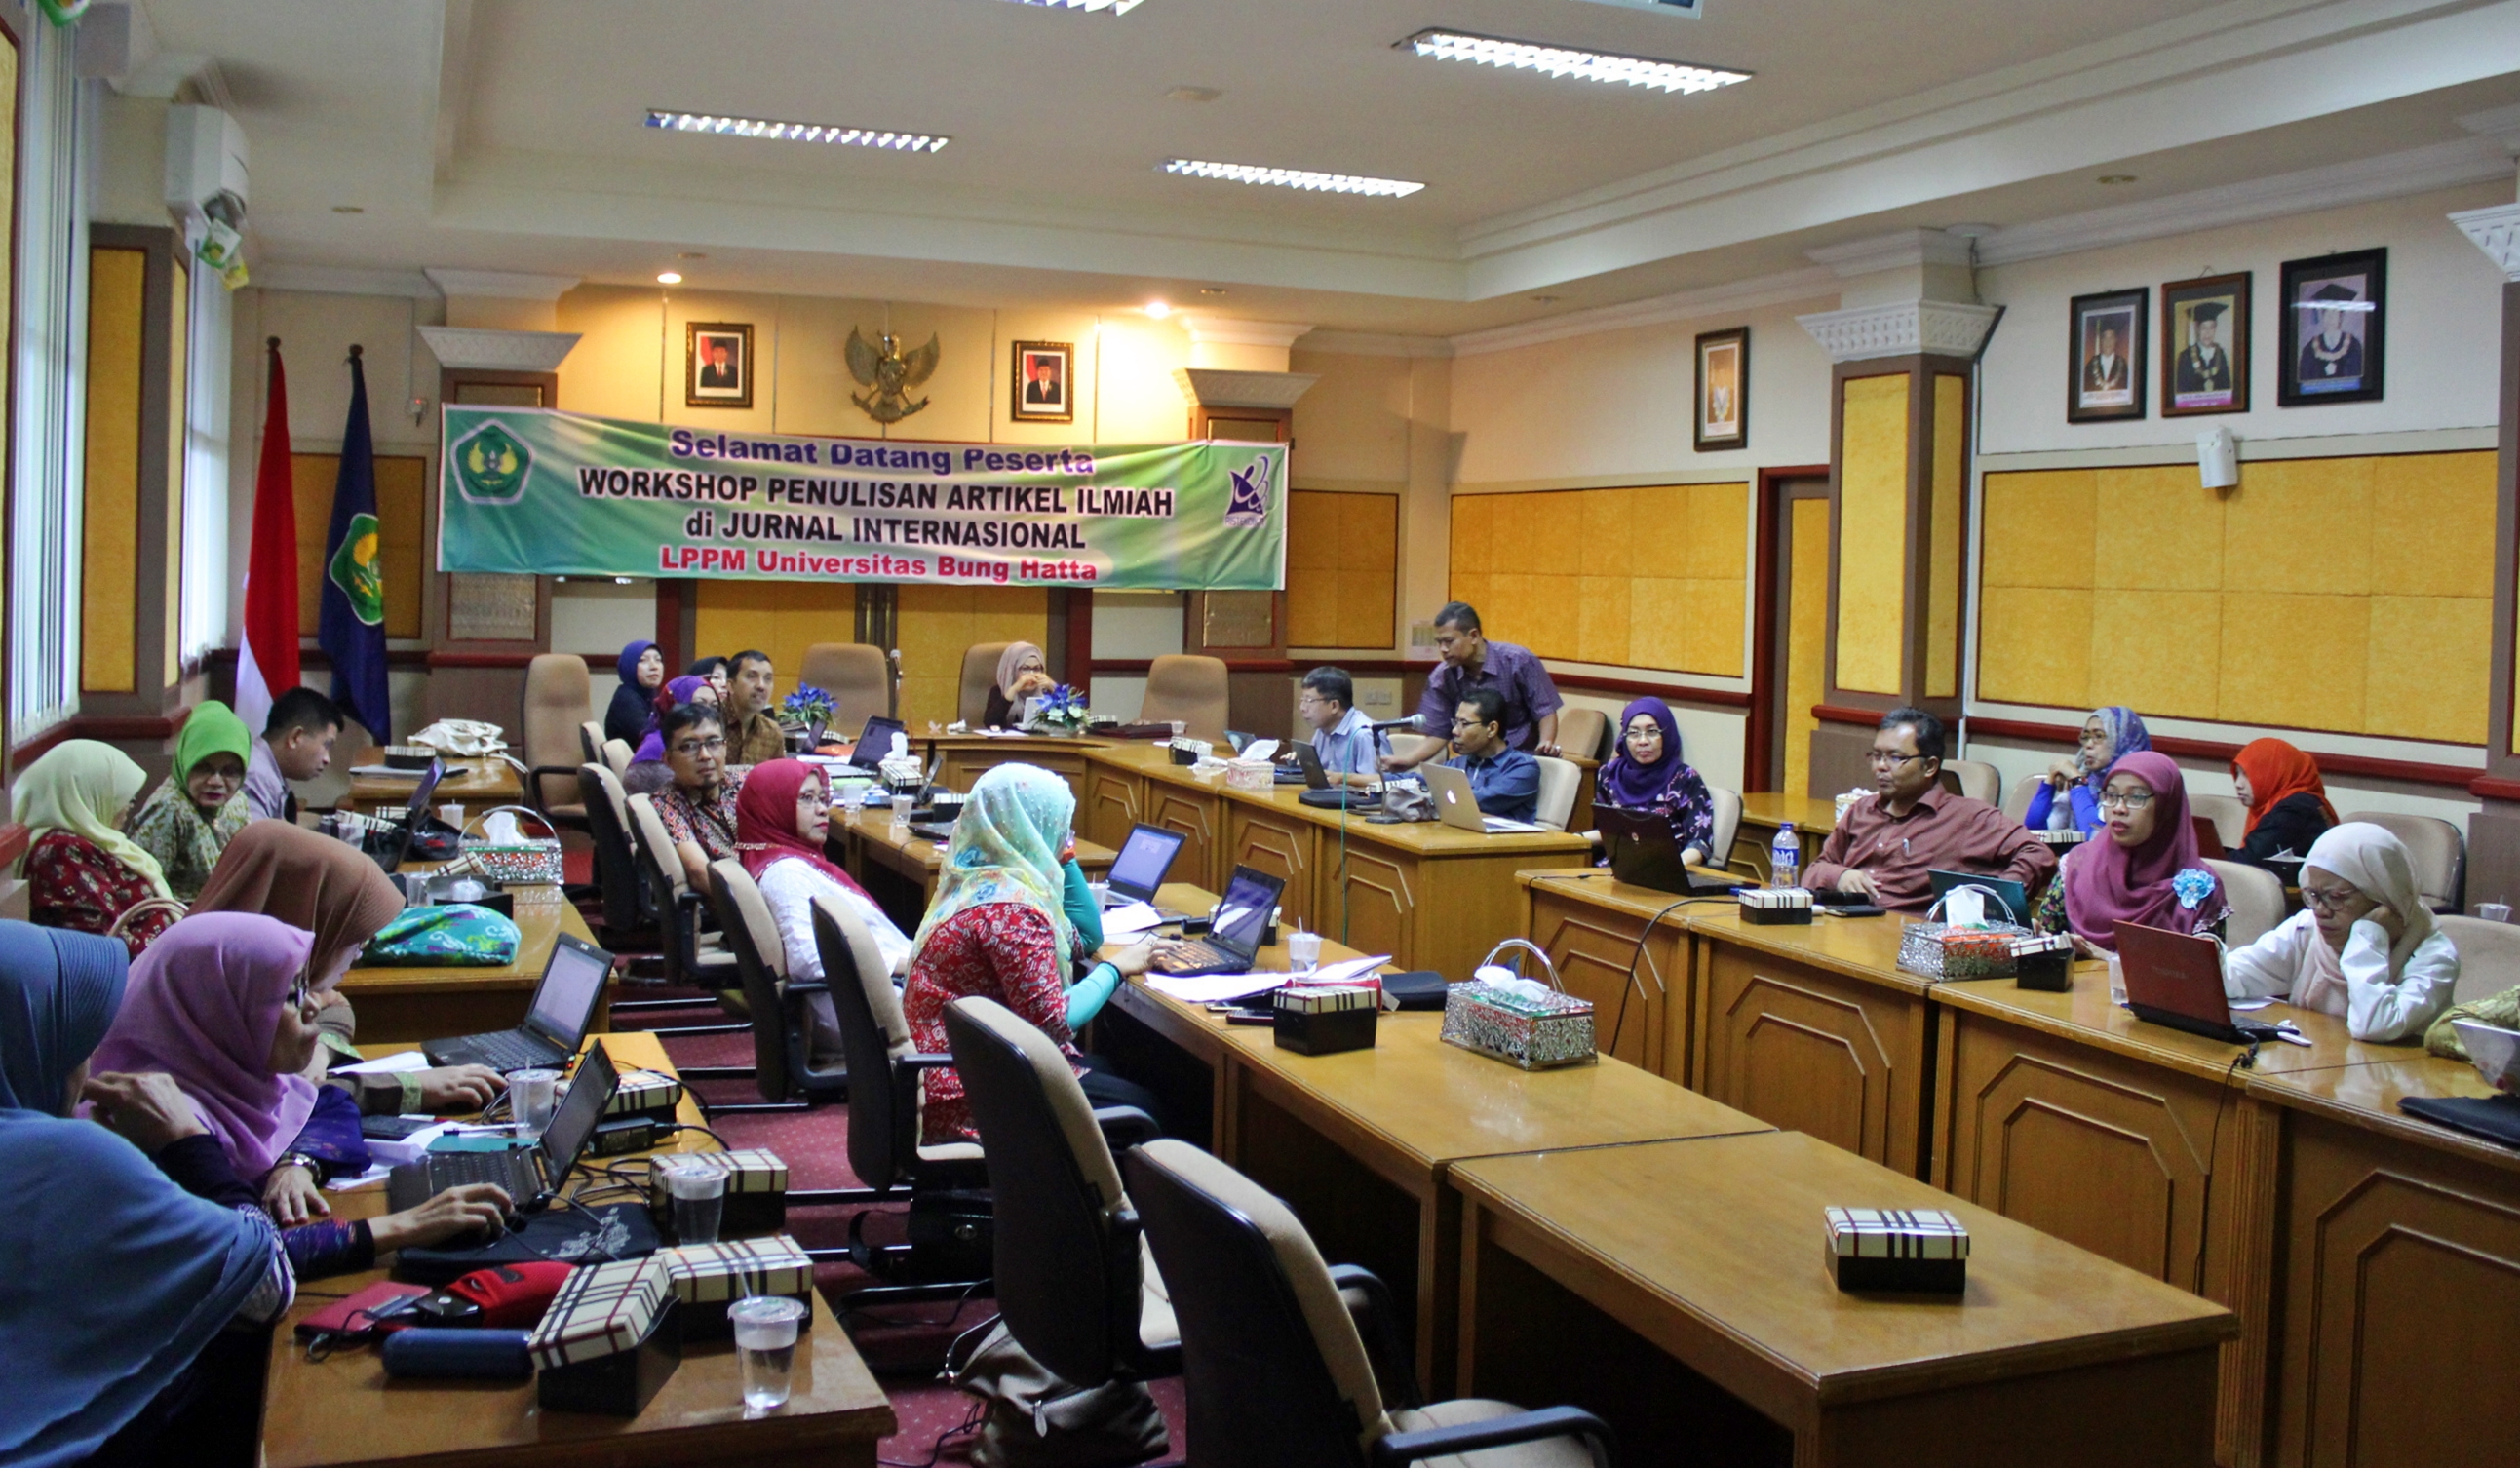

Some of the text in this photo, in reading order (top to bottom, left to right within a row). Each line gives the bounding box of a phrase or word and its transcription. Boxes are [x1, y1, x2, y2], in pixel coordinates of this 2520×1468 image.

[672, 430, 1094, 475] Selamat Datang Peserta
[580, 468, 1172, 516] WORKSHOP PENULISAN ARTIKEL ILMIAH
[686, 511, 1086, 549] di JURNAL INTERNASIONAL
[662, 547, 1097, 583] LPPM Universitas Bung Hatta
